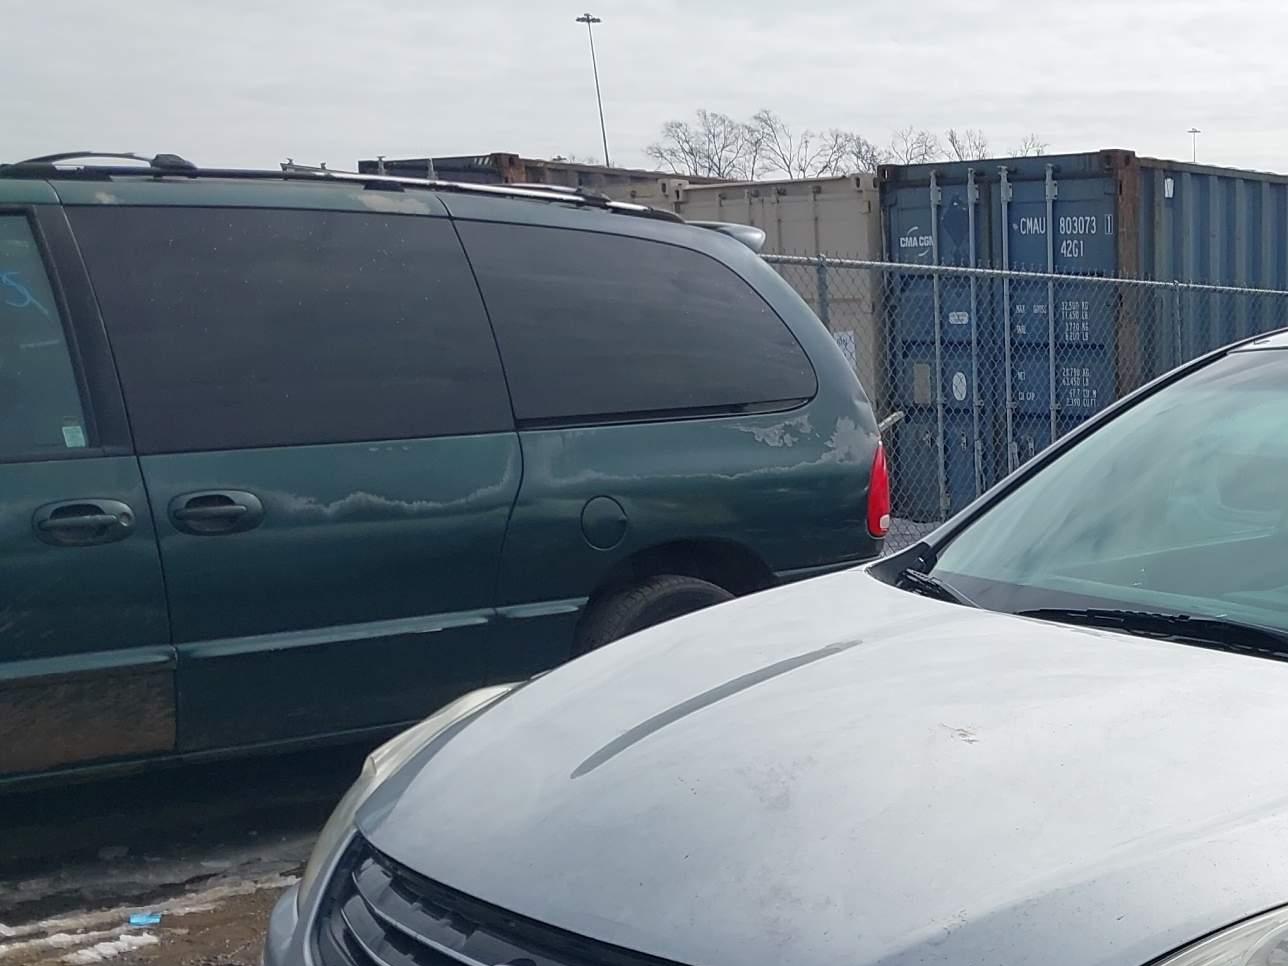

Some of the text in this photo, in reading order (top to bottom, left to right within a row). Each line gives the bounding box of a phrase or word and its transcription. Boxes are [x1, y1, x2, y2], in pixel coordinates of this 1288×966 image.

[1020, 218, 1046, 235] CMAU
[1059, 216, 1097, 234] 803073
[900, 236, 918, 248] CMA
[1060, 240, 1084, 257] 42G1
